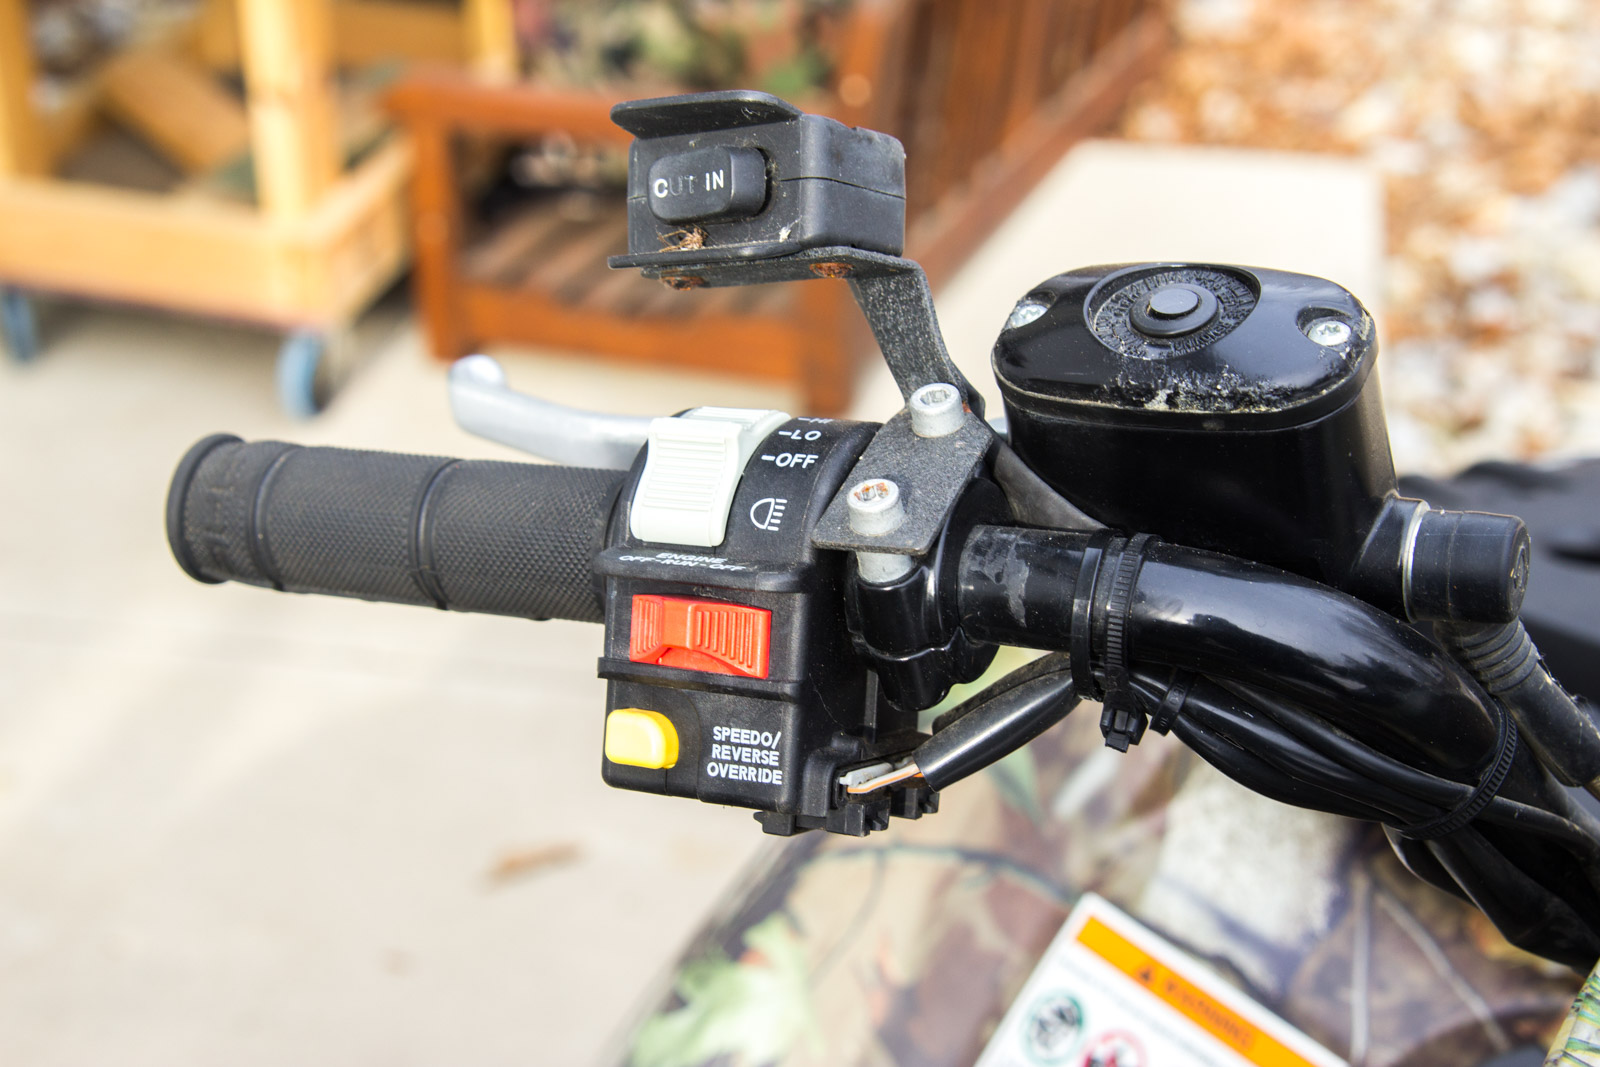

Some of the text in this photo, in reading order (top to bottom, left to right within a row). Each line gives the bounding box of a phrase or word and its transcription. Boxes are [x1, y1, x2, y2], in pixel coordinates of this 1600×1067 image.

[705, 169, 725, 192] IN
[655, 552, 728, 565] ENGINE
[713, 726, 782, 749] SPEEDO/
[712, 743, 780, 766] REVERSE
[706, 762, 783, 785] OVERRIDE
